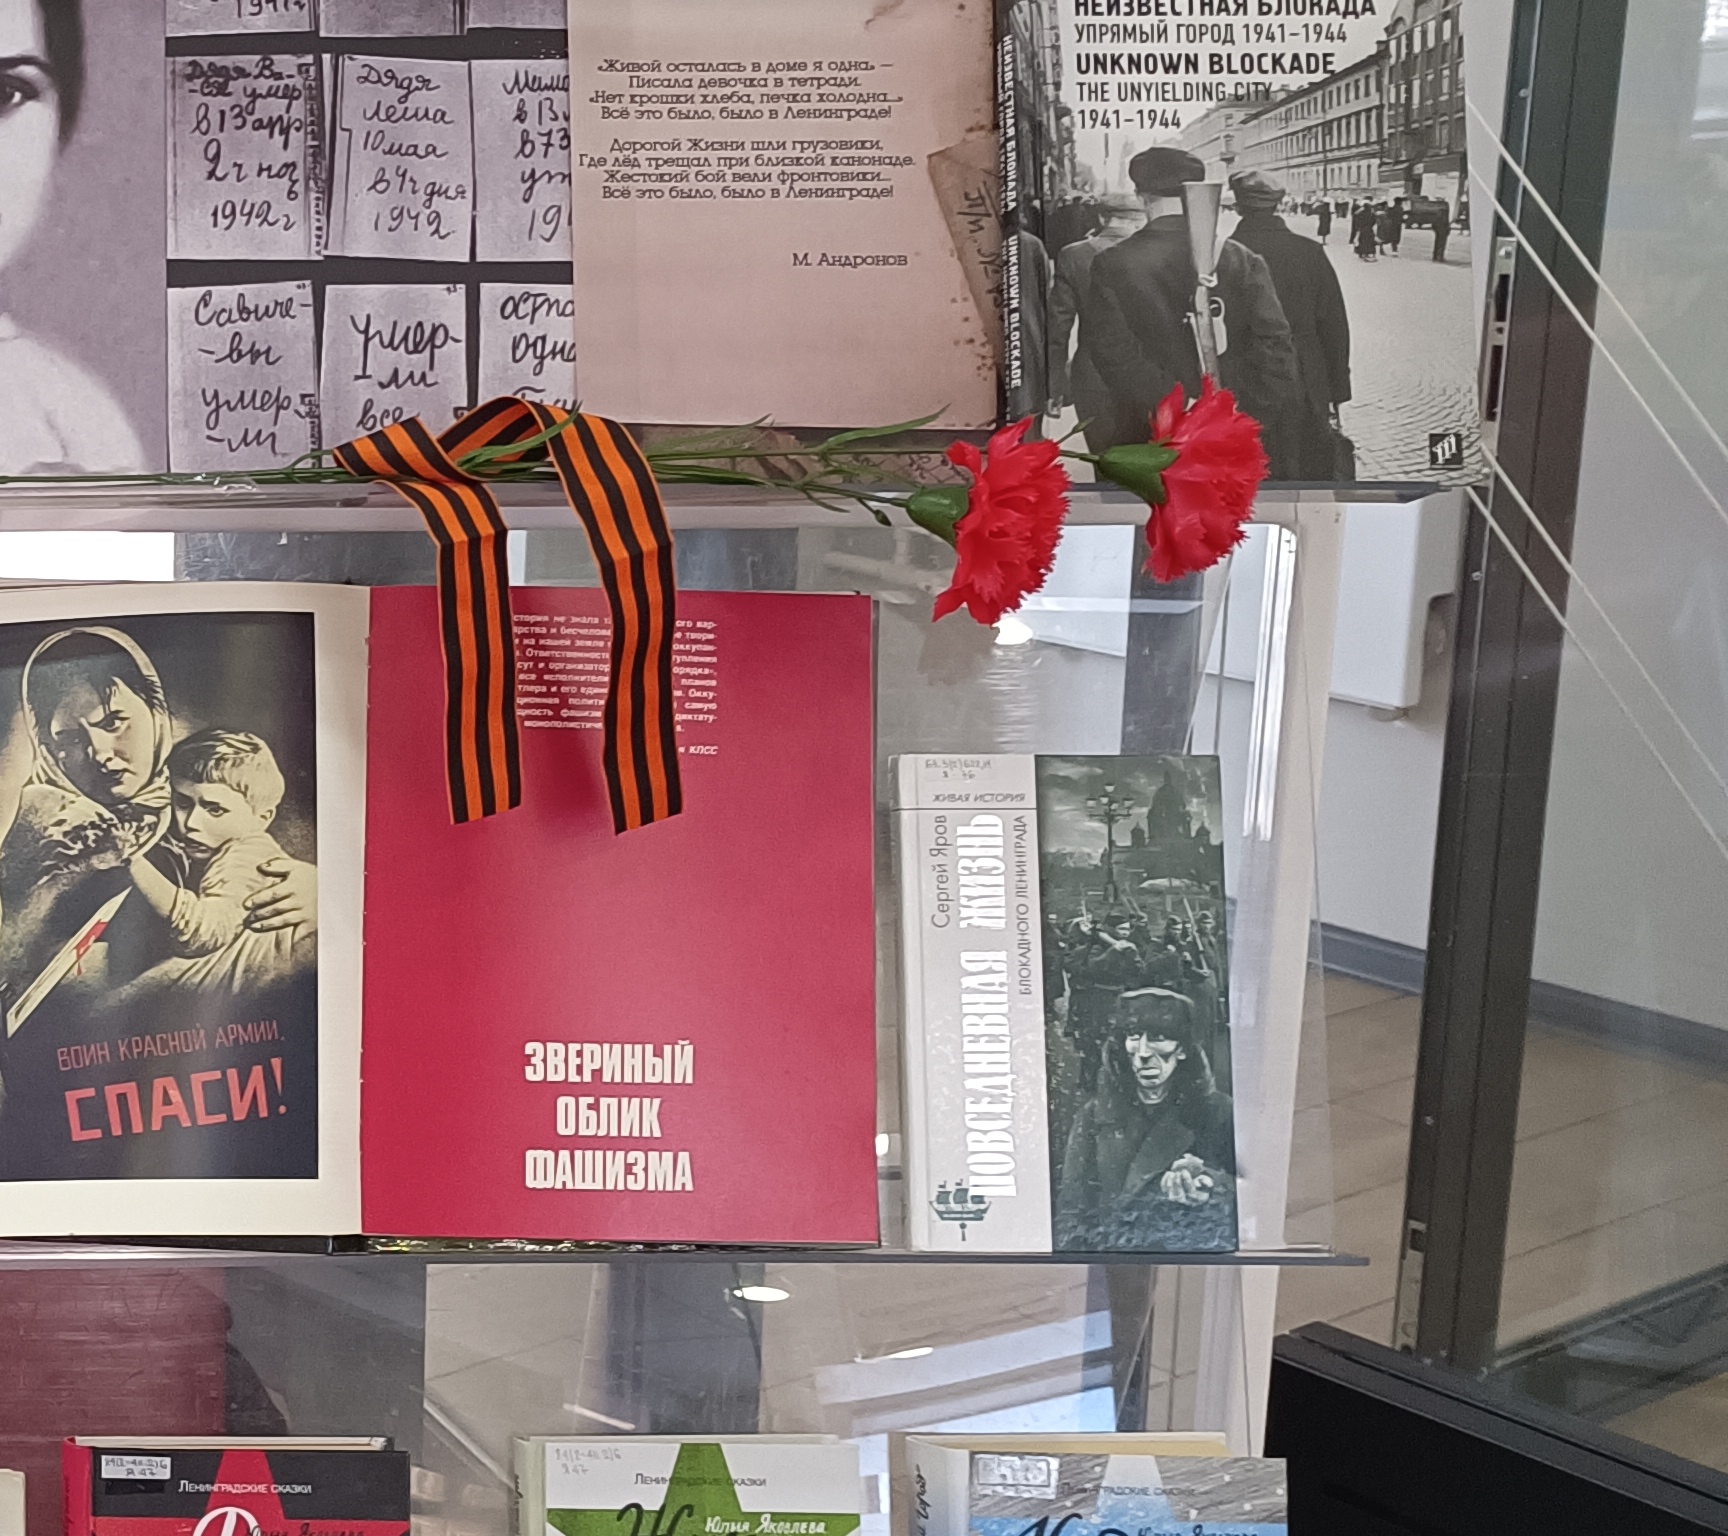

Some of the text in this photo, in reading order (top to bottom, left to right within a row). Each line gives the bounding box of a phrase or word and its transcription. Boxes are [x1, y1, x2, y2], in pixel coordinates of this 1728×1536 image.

[1074, 19, 1170, 45] УПРЯМЫЙ
[1175, 23, 1237, 47] ГОРОД
[597, 59, 662, 73] «Живой
[666, 61, 747, 72] осталась
[765, 61, 808, 73] доме
[1075, 52, 1337, 76] UNKNOWN BLOCKADE
[356, 63, 441, 105] Дядя
[628, 75, 769, 90] Писала девочка
[1076, 81, 1273, 104] THE UNYIELDING CITY
[589, 90, 812, 107] «Нет крошки хлеба, печка
[600, 105, 892, 121] Всё это было, было Ленинграде!
[610, 138, 884, 154] Дорогой Жизни шли грузовики,
[611, 154, 825, 170] лёд трещал близкой
[603, 169, 772, 183] Жестокий бой вели
[785, 185, 894, 201] Ленинграде!
[817, 253, 909, 270] Андронов
[973, 793, 1026, 803] ИСТОРИЯ
[929, 814, 955, 929] Сергей Яров
[1013, 815, 1033, 997] БЛОКАДНОГО ЛЕНИНГРАДА
[956, 814, 1018, 1198] ПОВСЕДНЕВНАЯ ЖИЗНЬ
[57, 1023, 207, 1071] ВОИН КРАСНОЙ
[524, 1038, 694, 1086] ЗВЕРИНЫЙ
[65, 1056, 287, 1142] СПАСИ!
[556, 1096, 662, 1139] ОБЛИК
[524, 1150, 694, 1192] ФАШИЗМА
